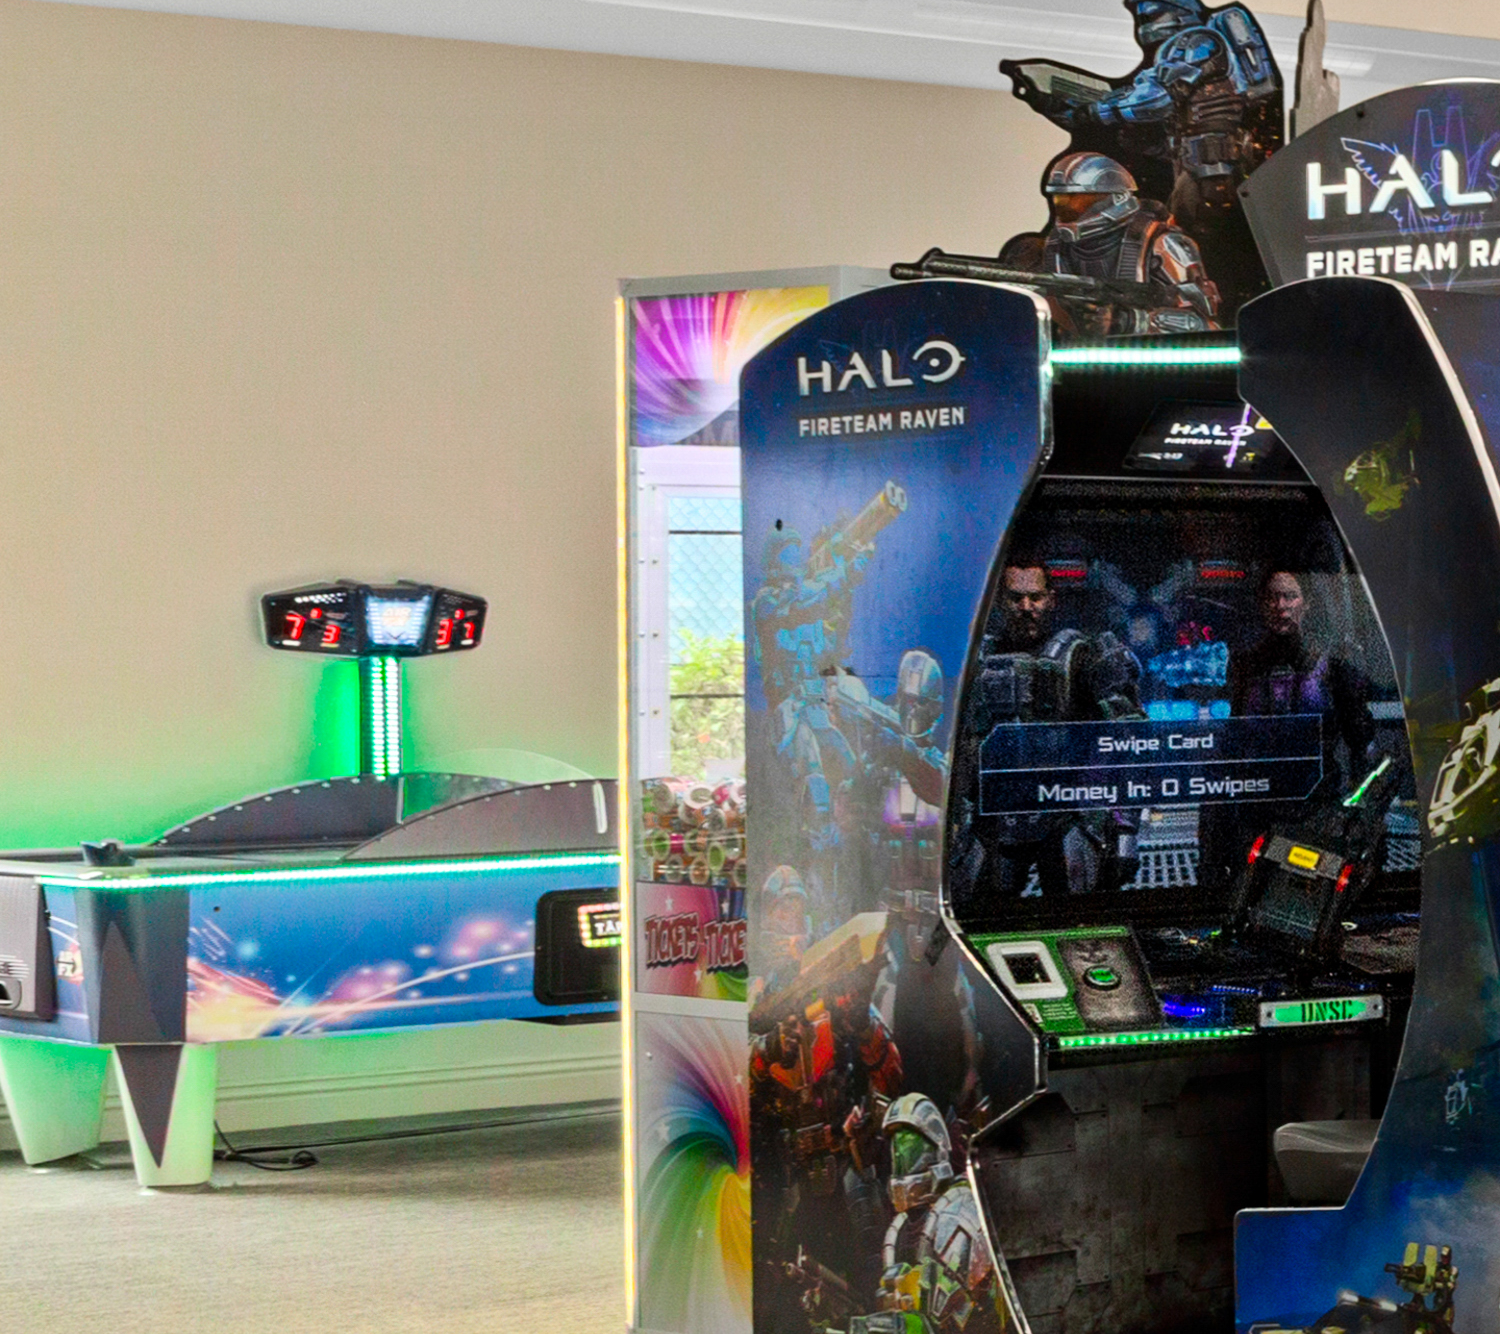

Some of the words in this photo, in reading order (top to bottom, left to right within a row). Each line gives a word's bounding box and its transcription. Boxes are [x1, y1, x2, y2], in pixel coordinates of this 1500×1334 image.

[1307, 241, 1458, 278] FIRETEAM
[797, 340, 966, 396] HALO
[799, 413, 893, 437] FIRETEAM
[900, 407, 965, 429] RAVEN
[1170, 423, 1255, 437] HALO
[1098, 736, 1160, 755] Swipe
[1168, 733, 1214, 750] Card
[1038, 781, 1117, 803] Money
[1127, 780, 1151, 798] In:
[1189, 776, 1270, 798] Swipes
[645, 914, 699, 966] TICKETS
[704, 919, 747, 970] TICKE
[1300, 999, 1353, 1024] UNSC
